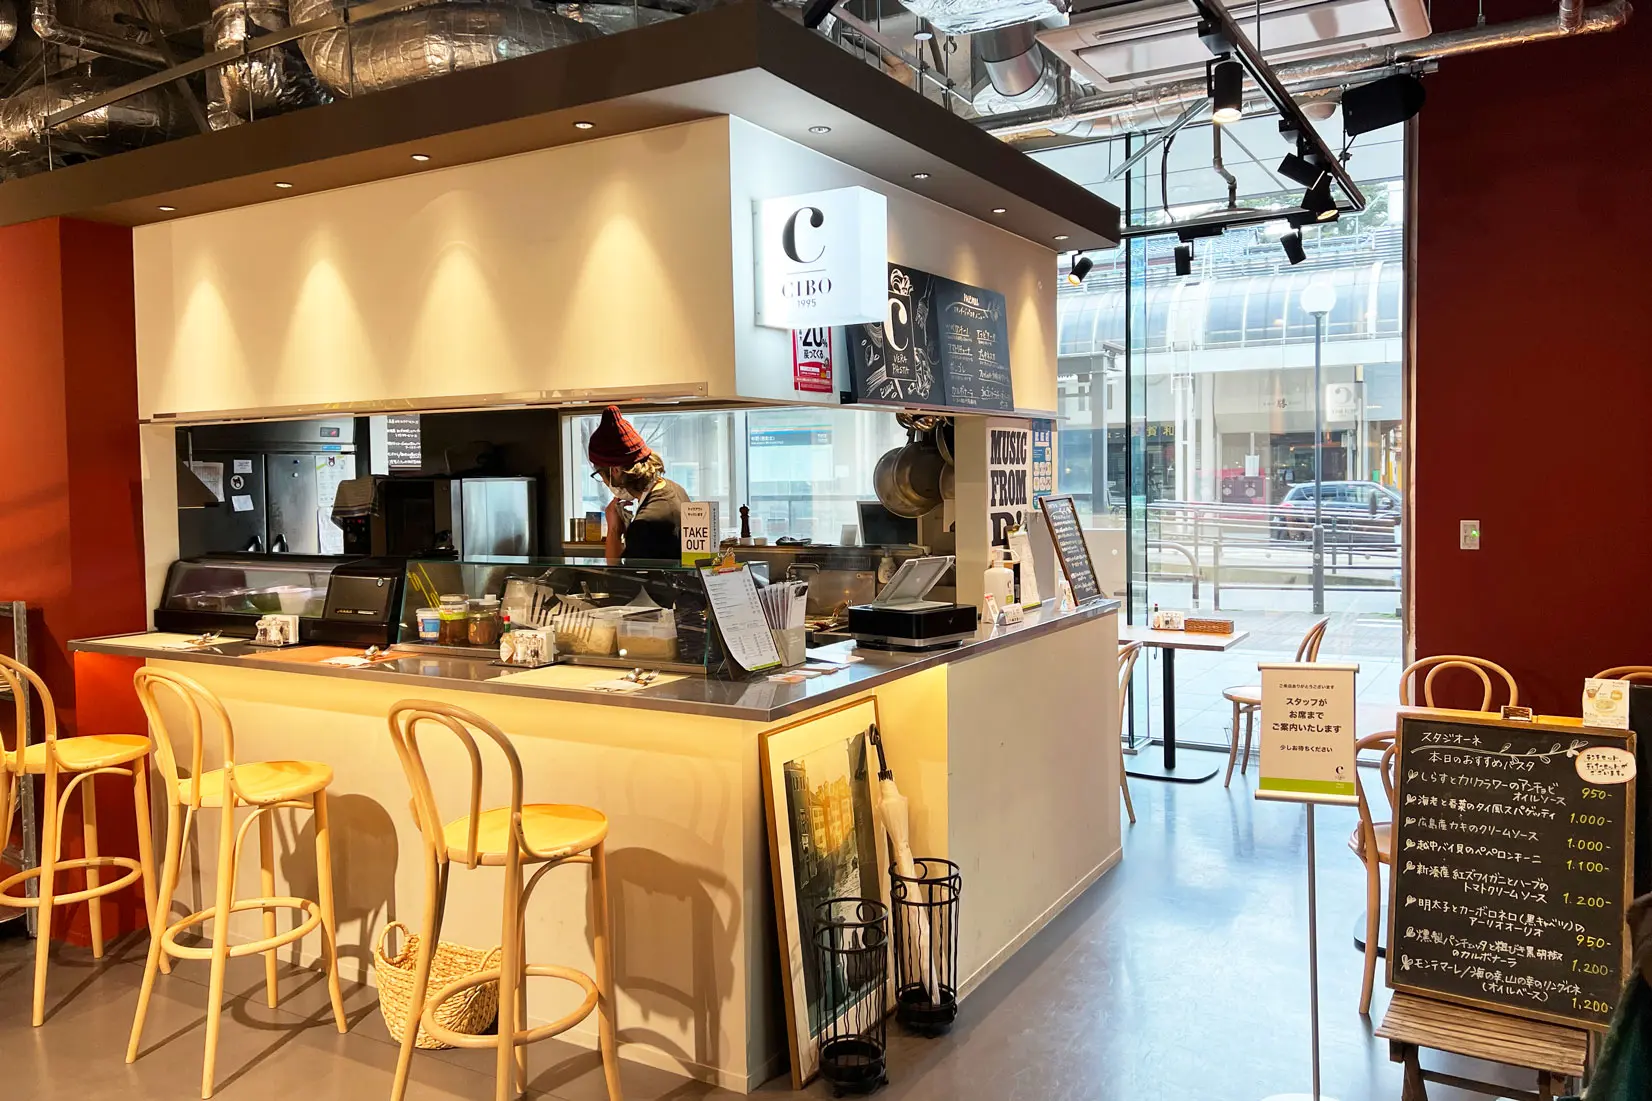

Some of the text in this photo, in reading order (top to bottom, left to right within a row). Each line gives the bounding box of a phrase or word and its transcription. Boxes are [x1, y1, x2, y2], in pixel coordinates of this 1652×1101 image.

[781, 206, 826, 264] C
[781, 278, 832, 299] CIBO
[797, 298, 817, 308] 1995
[883, 298, 909, 351] C
[803, 349, 825, 359] 戻ってくる
[892, 363, 910, 375] PASTA
[990, 430, 1027, 465] MUSIC
[990, 469, 1027, 507] FROM
[682, 526, 708, 538] TAKE
[686, 539, 706, 551] OUT
[1286, 697, 1328, 707] スタッフが
[1289, 710, 1324, 720] お席まで
[1272, 722, 1342, 733] ご案内いたします
[1421, 732, 1482, 746] スタジオーネ
[1280, 744, 1333, 753] 少しお待ちください
[1428, 750, 1535, 772] 本日のおすすめパスタ
[1512, 792, 1567, 807] オイルソース
[1417, 815, 1540, 842] 広島産カキのクリームソース
[1464, 882, 1548, 904] トマトクリームソース
[1468, 916, 1544, 938] アーリオオーリオ
[1481, 981, 1549, 1003] (オイルベース)
